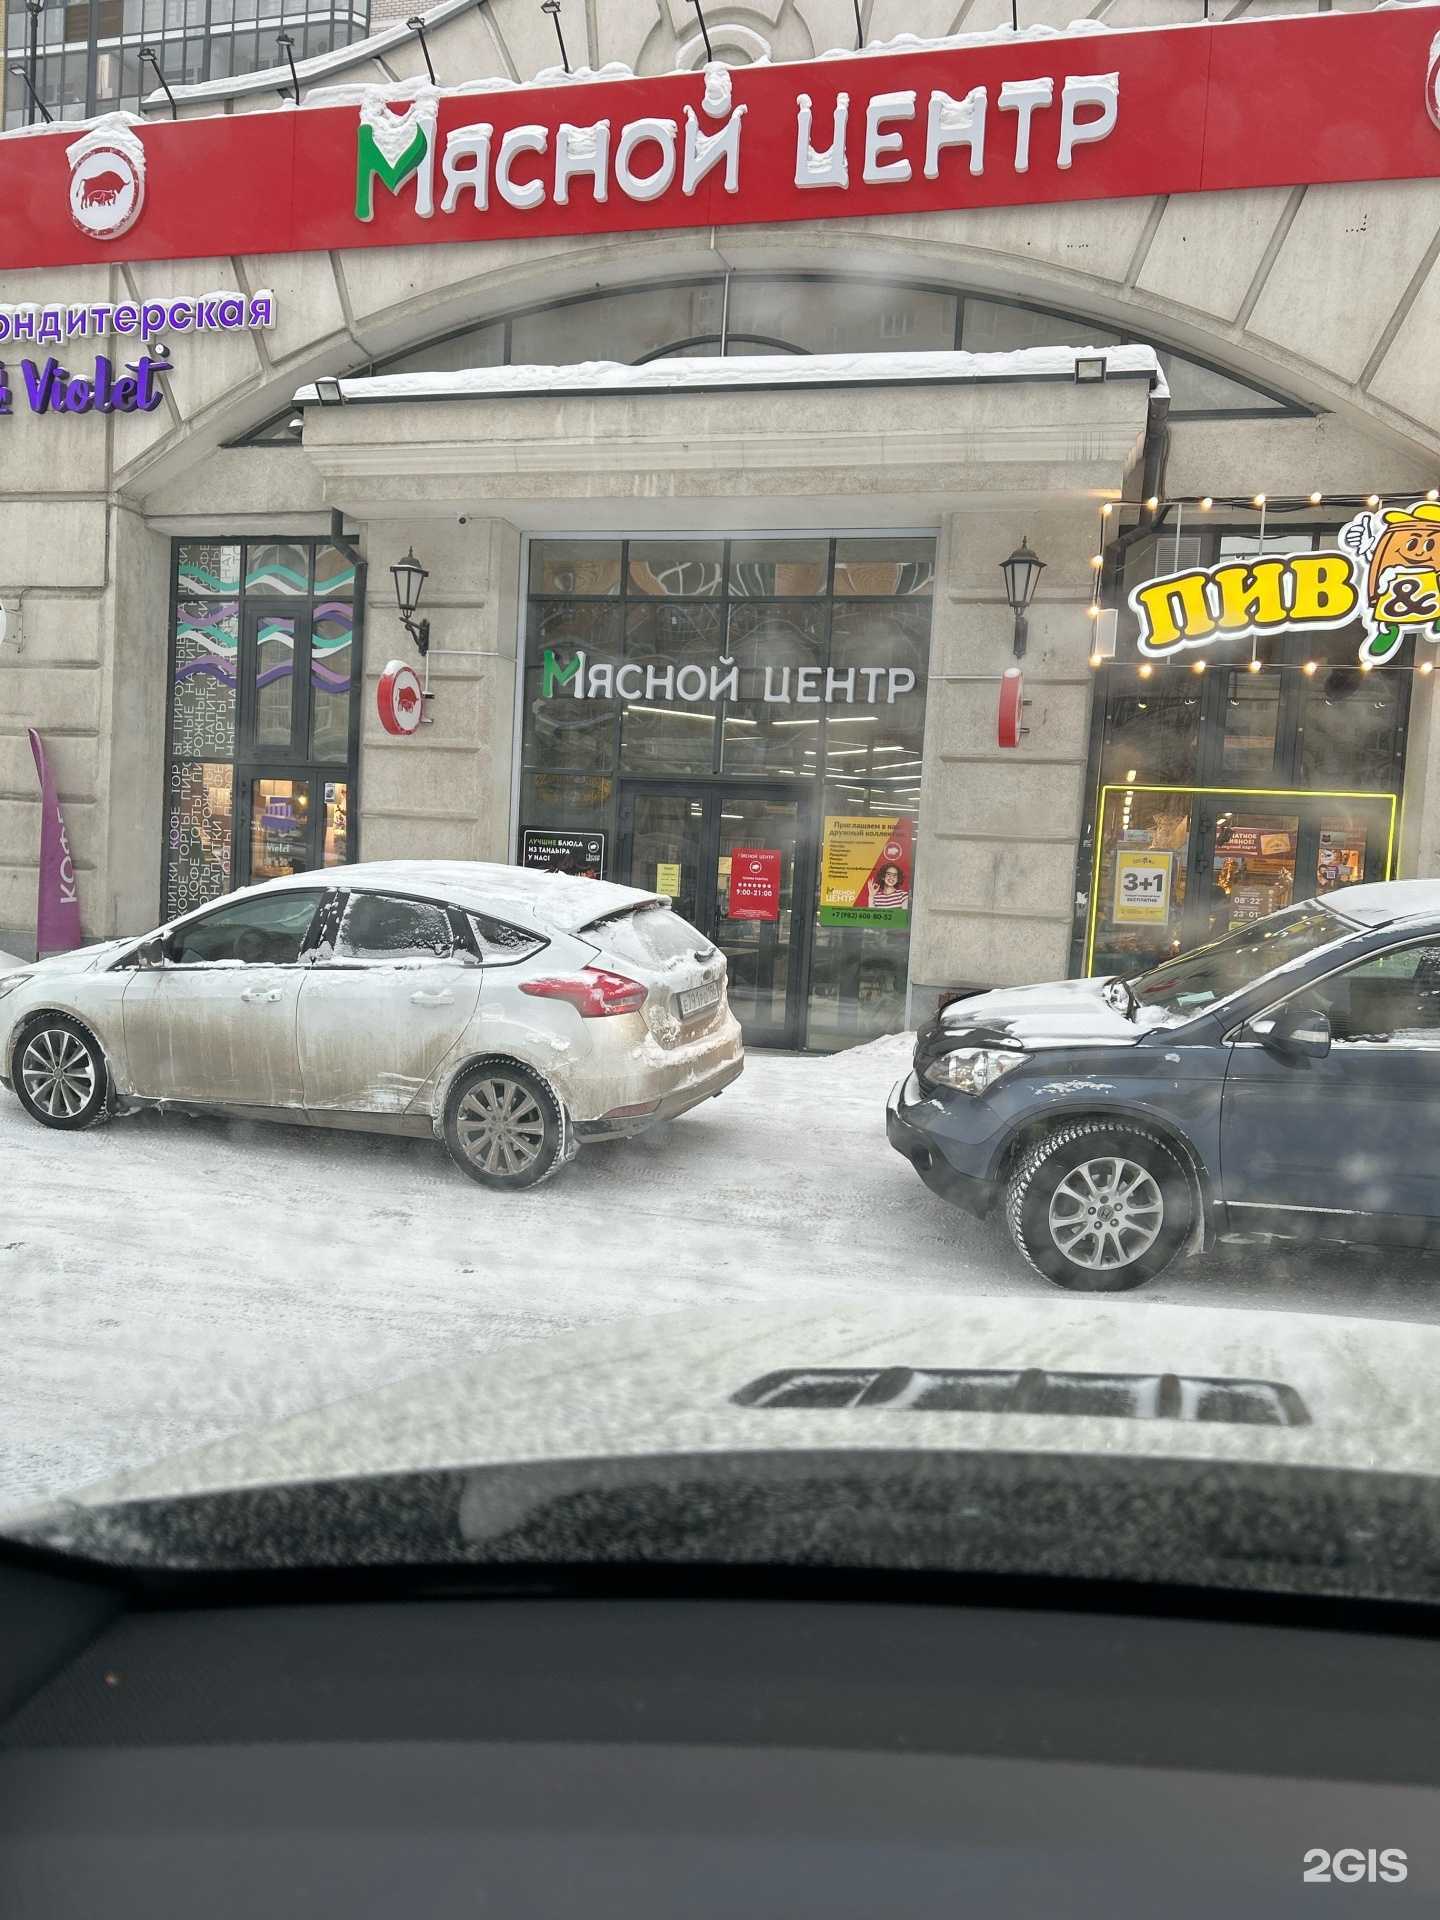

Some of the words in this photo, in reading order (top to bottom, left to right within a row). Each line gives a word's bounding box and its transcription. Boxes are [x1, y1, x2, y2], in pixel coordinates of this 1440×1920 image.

[355, 92, 747, 222] МЯСНОЙ
[794, 73, 1120, 190] ЦЕНТР
[21, 355, 174, 414] Violet
[1138, 556, 1355, 647] ПИВ
[542, 649, 740, 702] МЯСНОЙ
[765, 665, 916, 704] ЦЕНТР
[214, 701, 226, 752] ТОРТЫ
[169, 807, 180, 849] КОФЕ
[179, 812, 190, 864] ТОРТЫ
[190, 795, 201, 846] ТОРТЫ
[558, 839, 583, 847] БЛЮДА
[189, 857, 200, 901] КОФЕ
[211, 820, 222, 895] НАПИТКИ
[1123, 872, 1164, 892] 3+1
[167, 862, 179, 922] АПИТКИ
[200, 864, 210, 905] ОРТЫ
